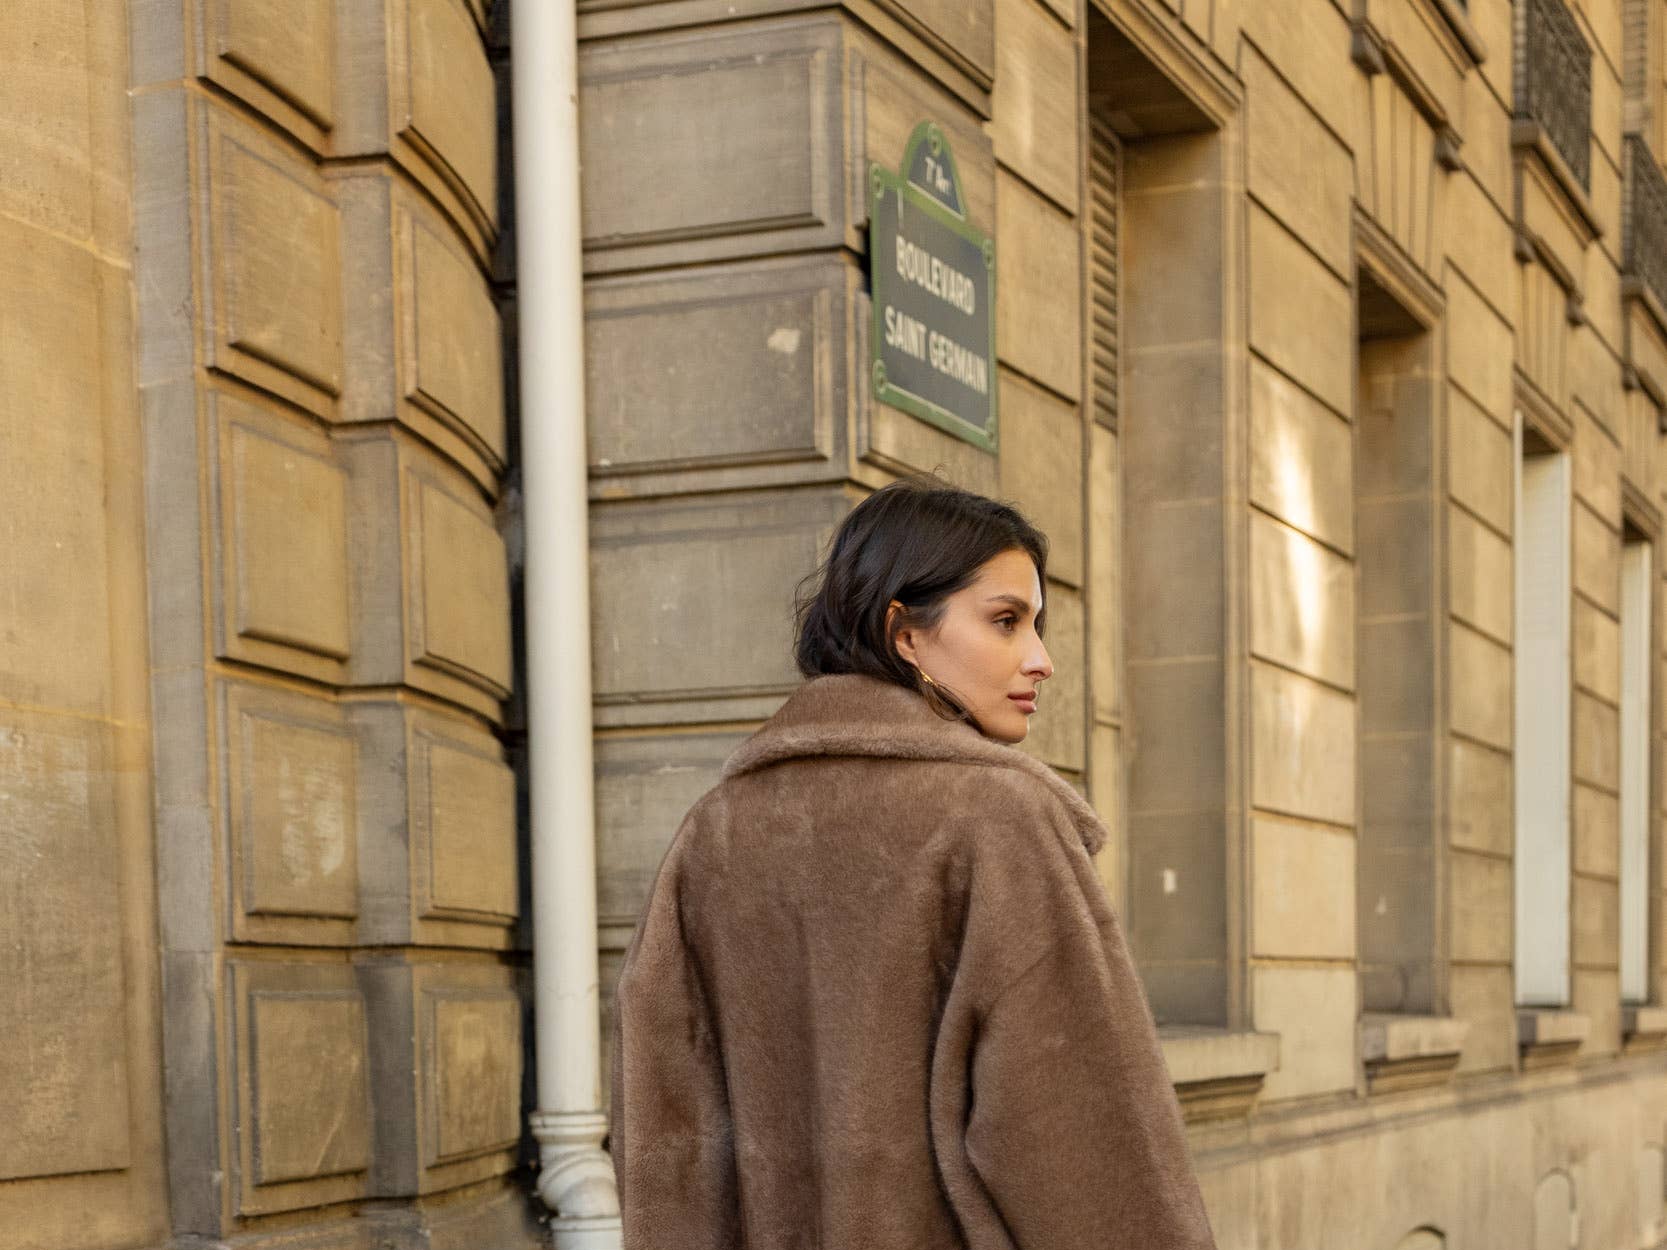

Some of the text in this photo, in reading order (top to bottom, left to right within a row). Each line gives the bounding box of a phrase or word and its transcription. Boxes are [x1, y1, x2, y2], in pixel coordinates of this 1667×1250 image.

[896, 234, 976, 316] BOULEVARD
[885, 305, 988, 394] SAINT GERMAIN
